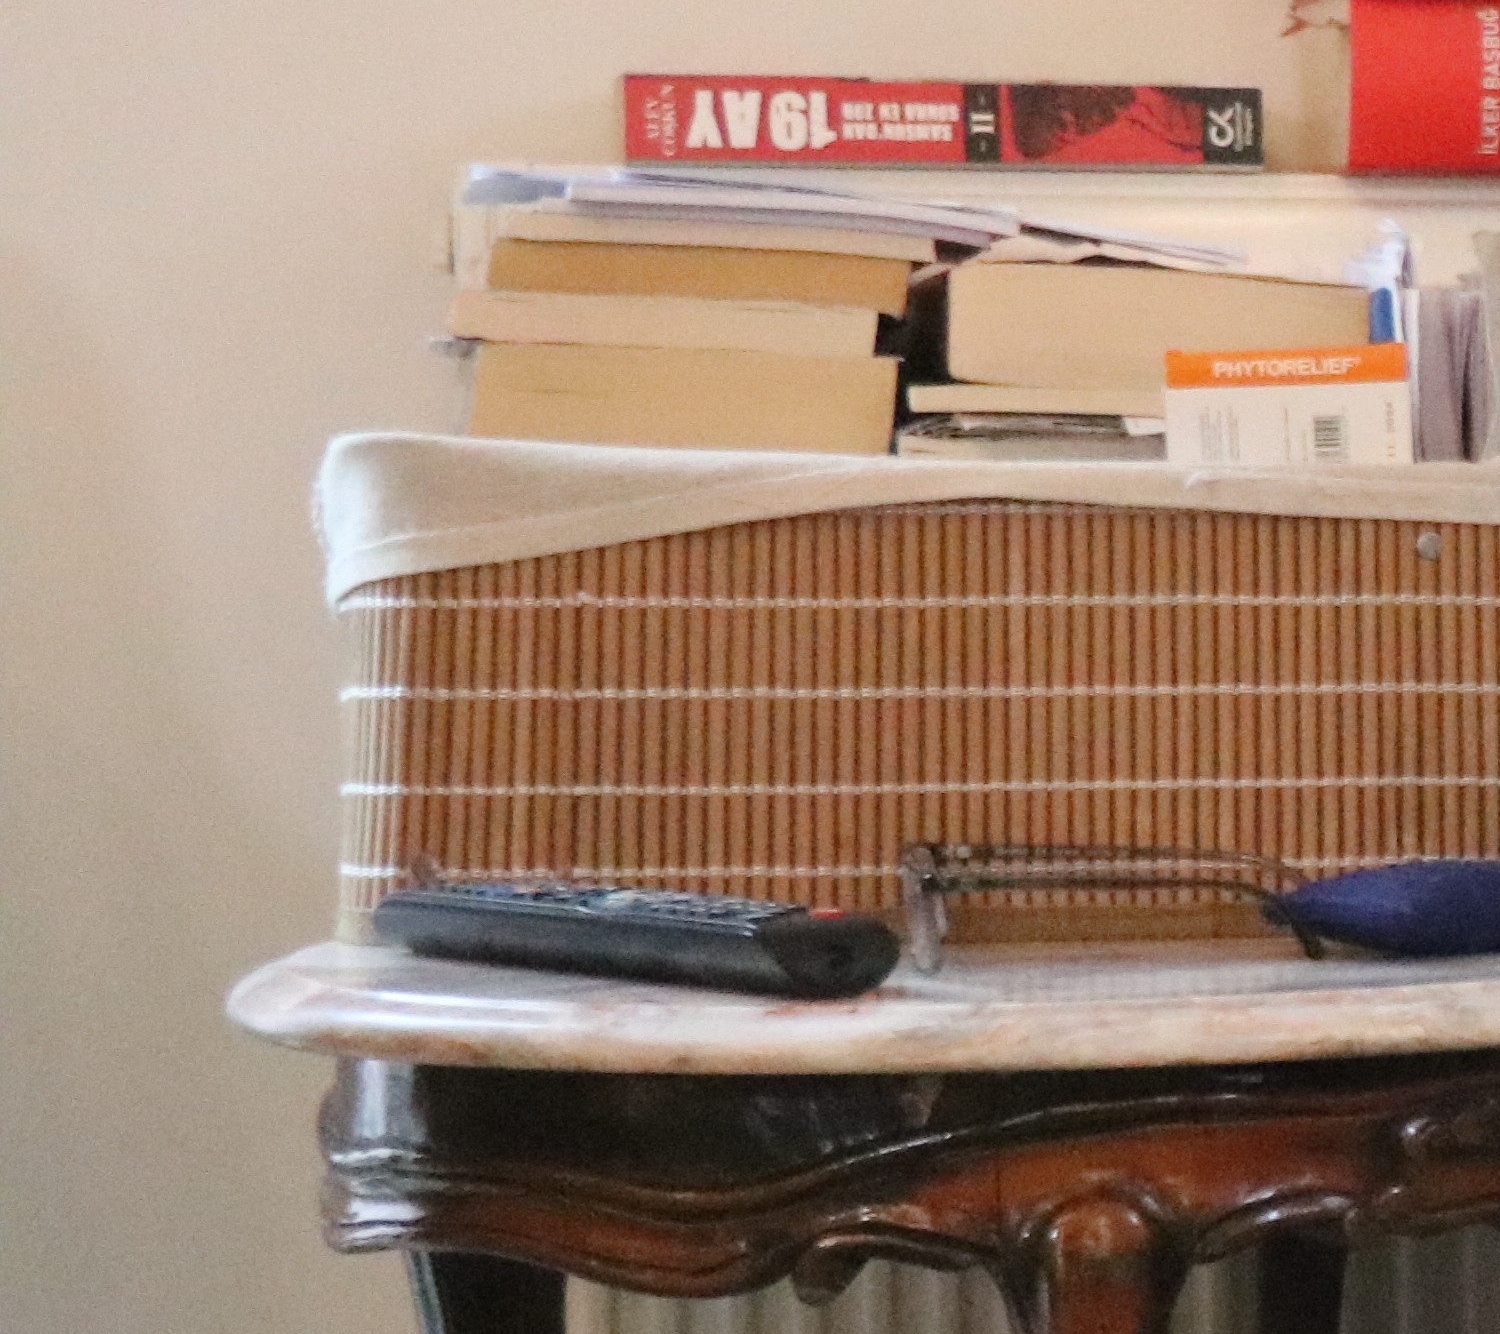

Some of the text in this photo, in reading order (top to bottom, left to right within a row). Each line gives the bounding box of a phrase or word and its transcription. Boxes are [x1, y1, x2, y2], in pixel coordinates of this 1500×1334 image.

[686, 88, 838, 152] 19 AY
[1477, 96, 1500, 155] İLKER
[1211, 355, 1356, 379] PHYTORELIEF
